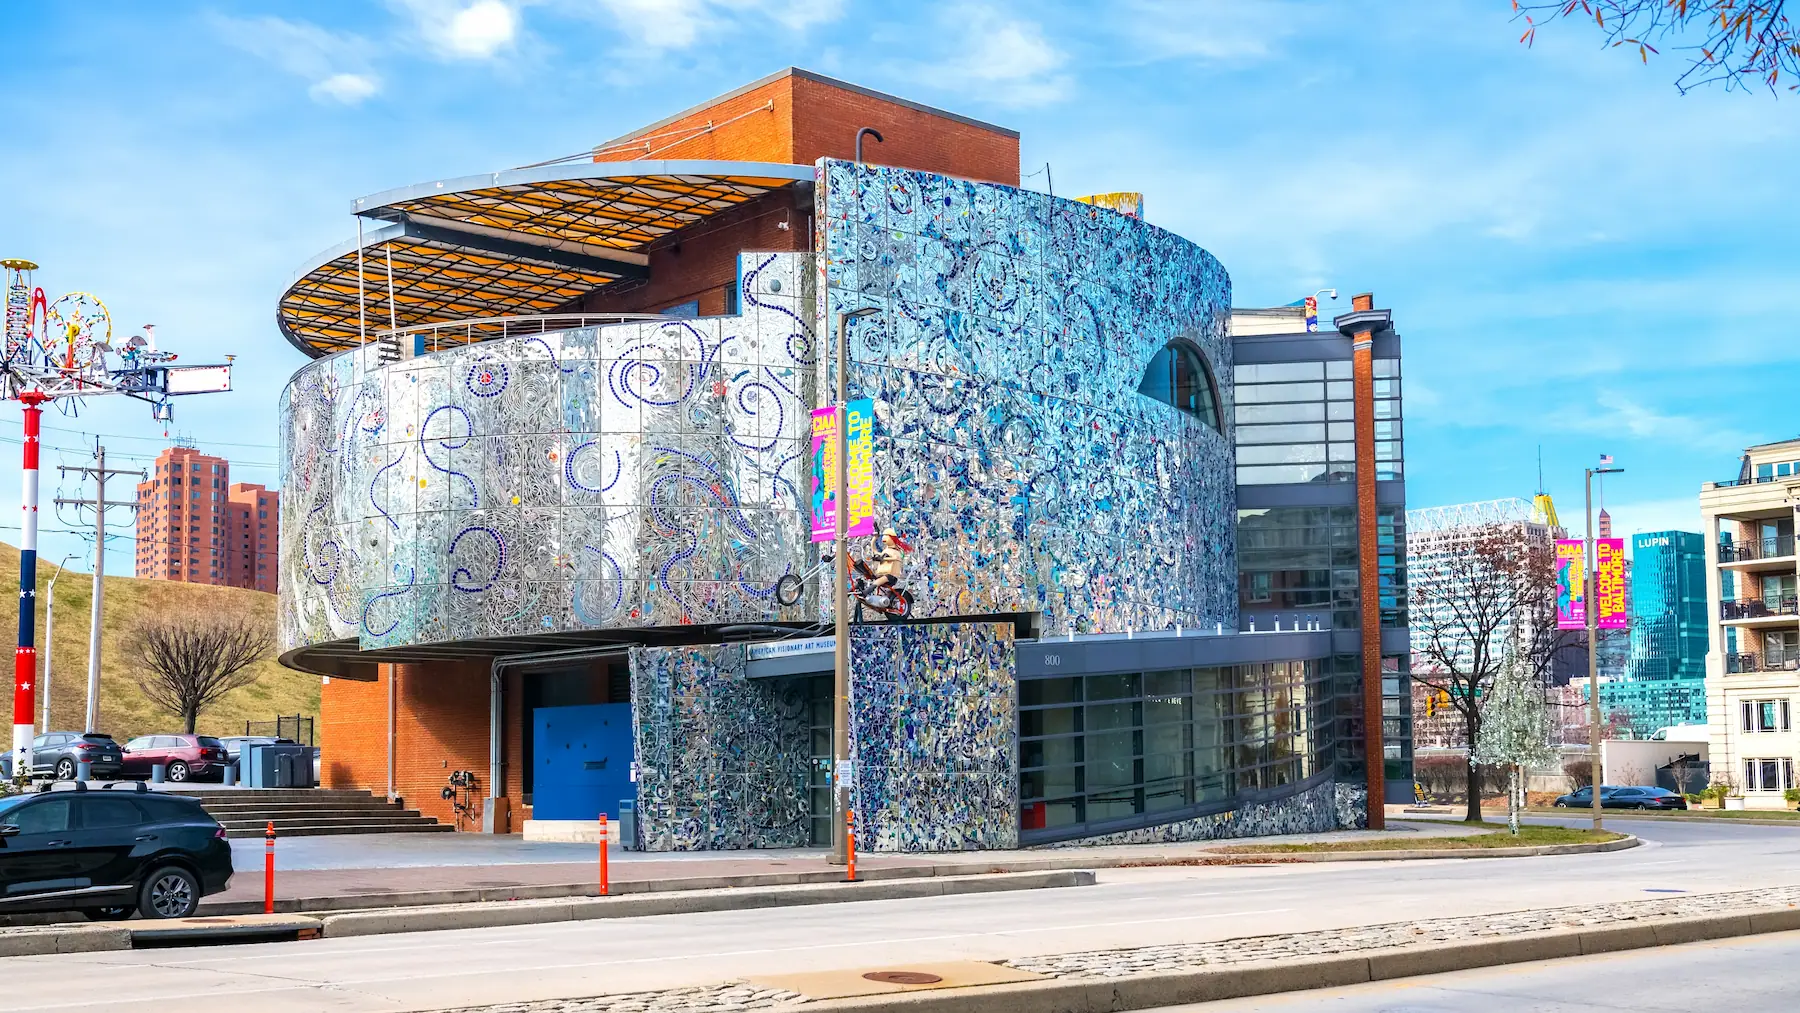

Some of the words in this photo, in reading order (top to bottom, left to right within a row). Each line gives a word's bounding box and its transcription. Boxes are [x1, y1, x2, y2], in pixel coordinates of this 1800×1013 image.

[813, 414, 836, 431] CIAA
[848, 411, 861, 436] TO
[860, 416, 873, 517] BALTIMORE
[848, 439, 861, 527] WELCOME
[1557, 544, 1583, 555] CIAA
[1598, 543, 1611, 559] TO
[1638, 536, 1669, 549] LUPIN
[1598, 560, 1612, 619] WELCOME
[1610, 548, 1625, 613] BALTIMORE
[751, 646, 776, 656] AMERICAN
[777, 644, 803, 653] VISIONARY
[805, 642, 814, 650] ART
[1044, 654, 1061, 666] 800
[656, 667, 670, 820] ENTRANCE
